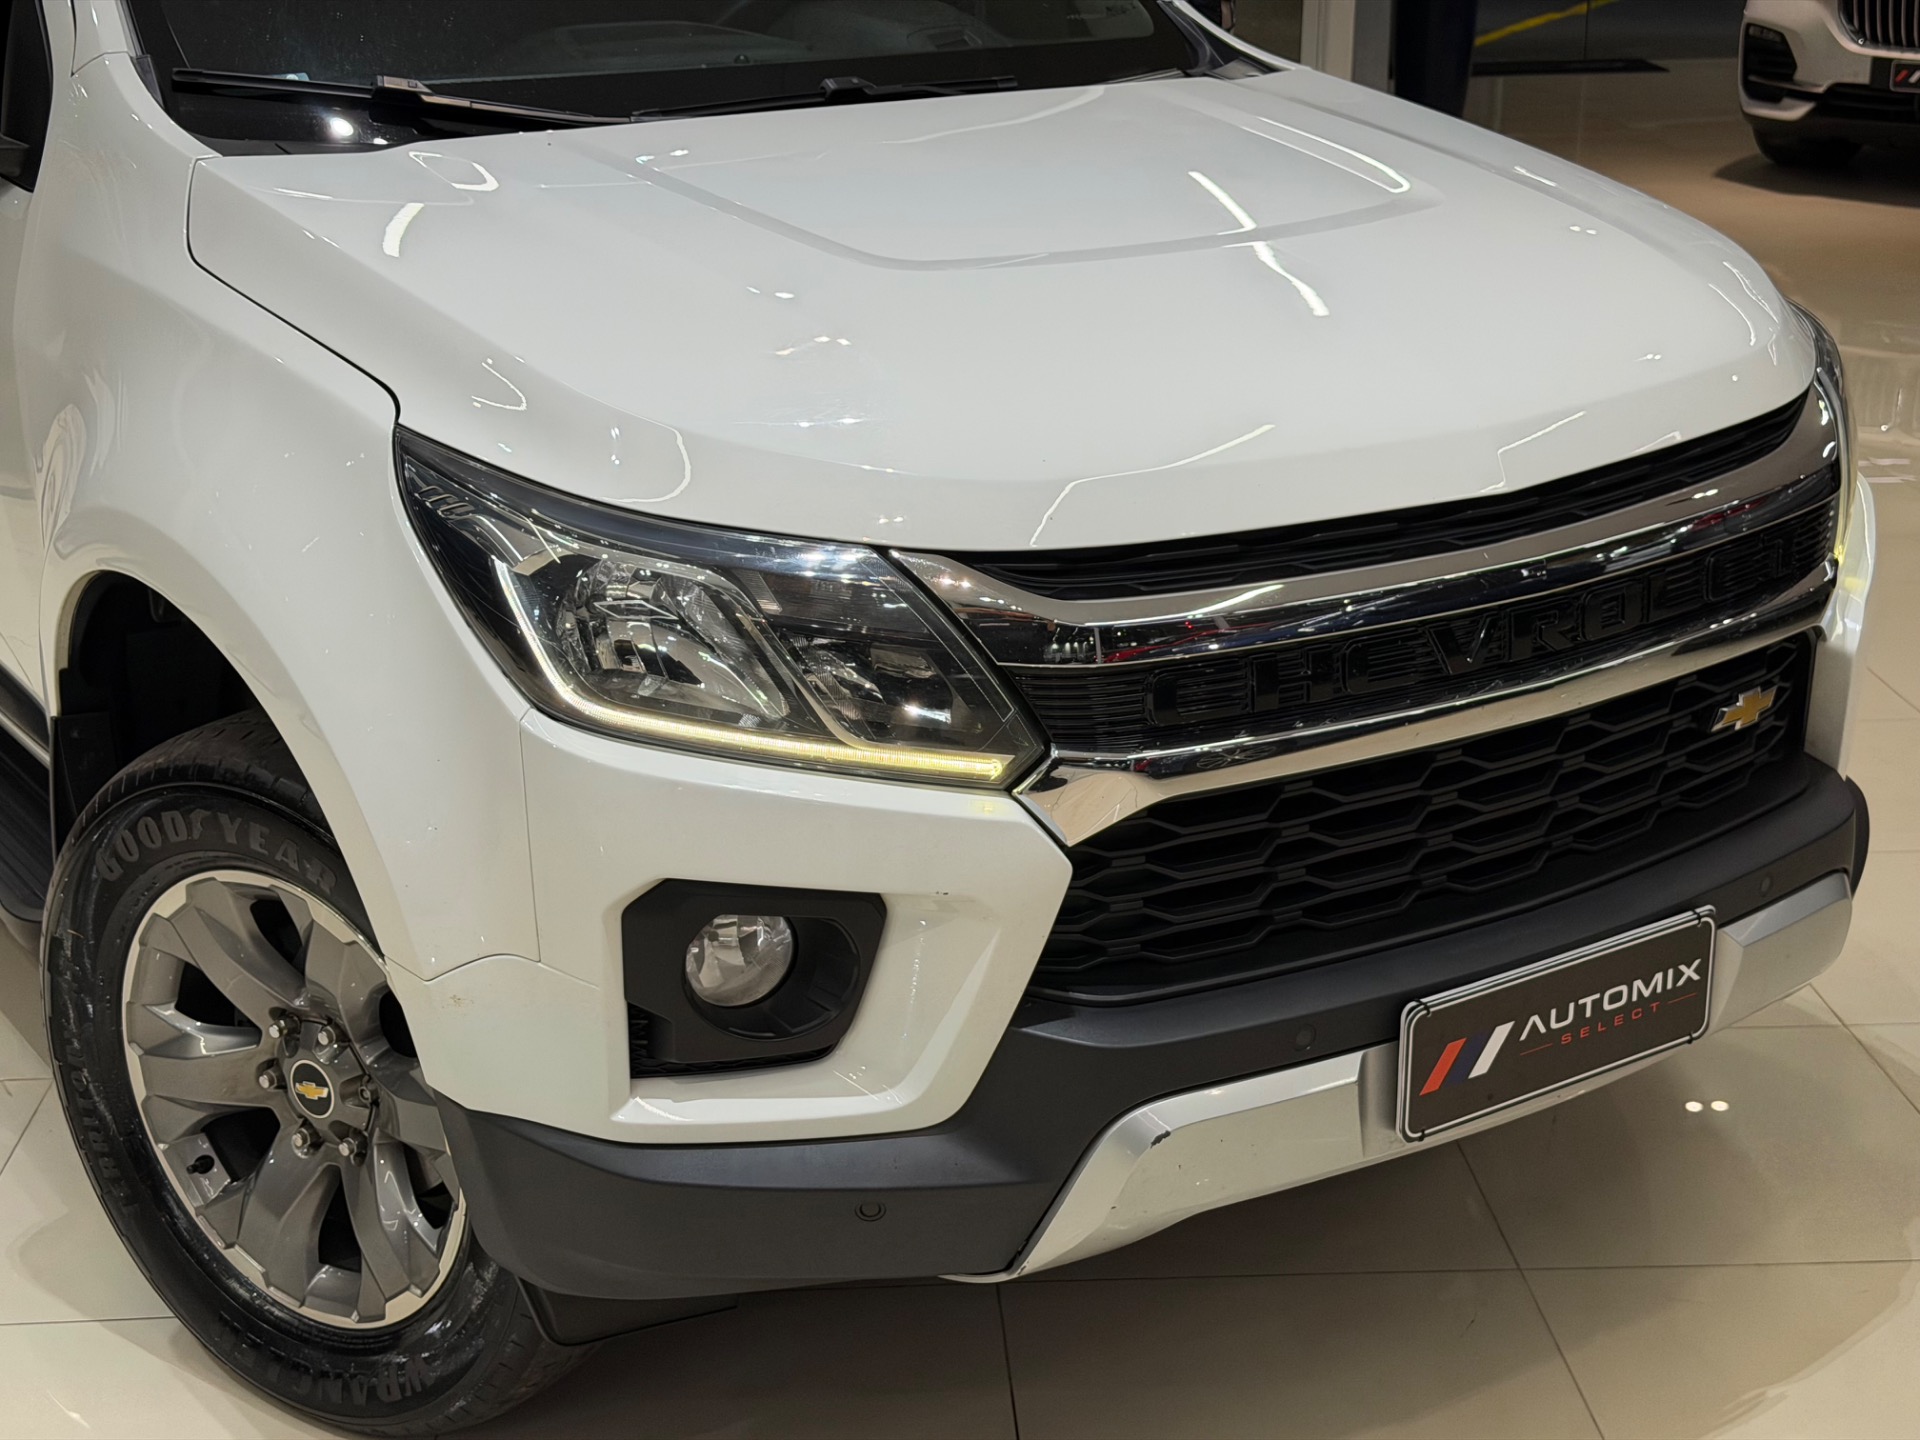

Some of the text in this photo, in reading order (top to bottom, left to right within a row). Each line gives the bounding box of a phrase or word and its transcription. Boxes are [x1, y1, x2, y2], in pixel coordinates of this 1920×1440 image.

[1143, 530, 1798, 726] CHEVROLET
[1519, 958, 1702, 1042] AUTOMIX
[1560, 1001, 1662, 1045] SELECT
